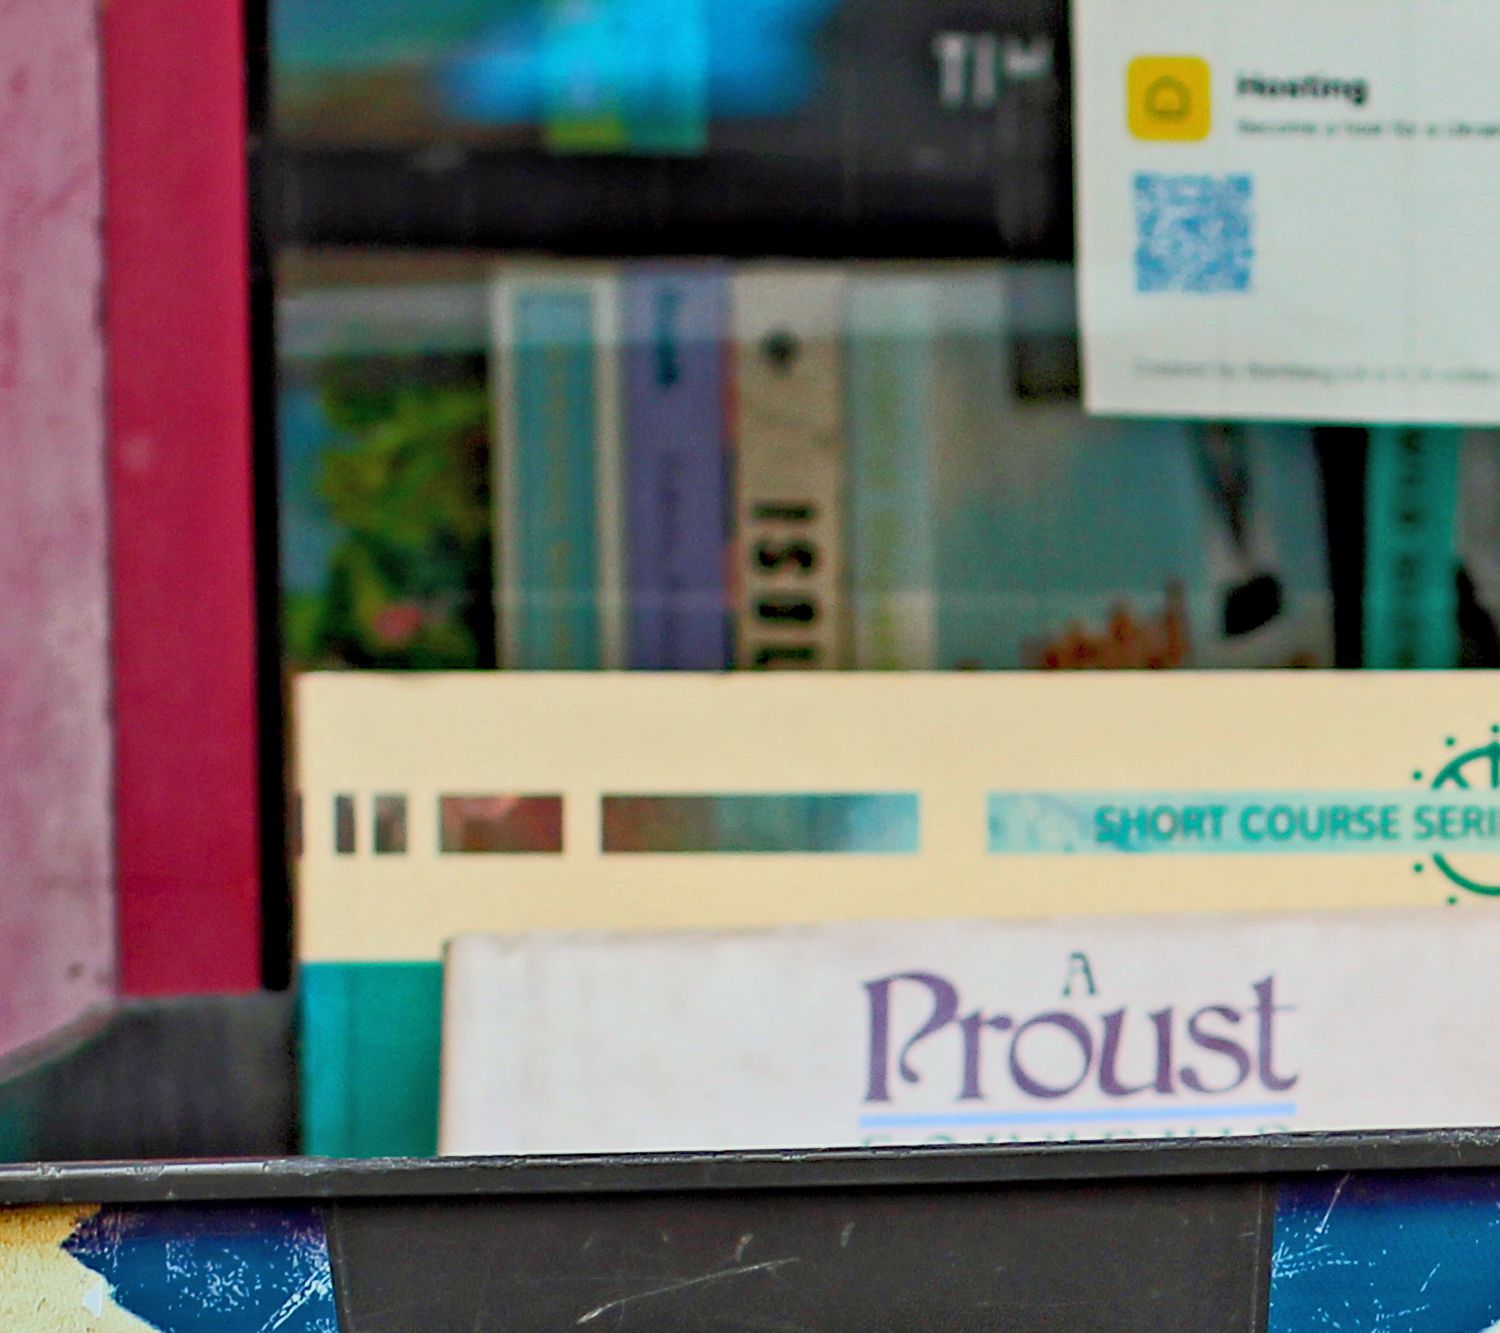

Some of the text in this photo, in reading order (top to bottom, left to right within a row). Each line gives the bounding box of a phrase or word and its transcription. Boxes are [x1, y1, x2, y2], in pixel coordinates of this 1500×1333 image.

[1094, 804, 1230, 843] SHORT
[1239, 803, 1399, 842] COURSE
[1062, 951, 1098, 998] A
[861, 969, 1300, 1104] Proust
